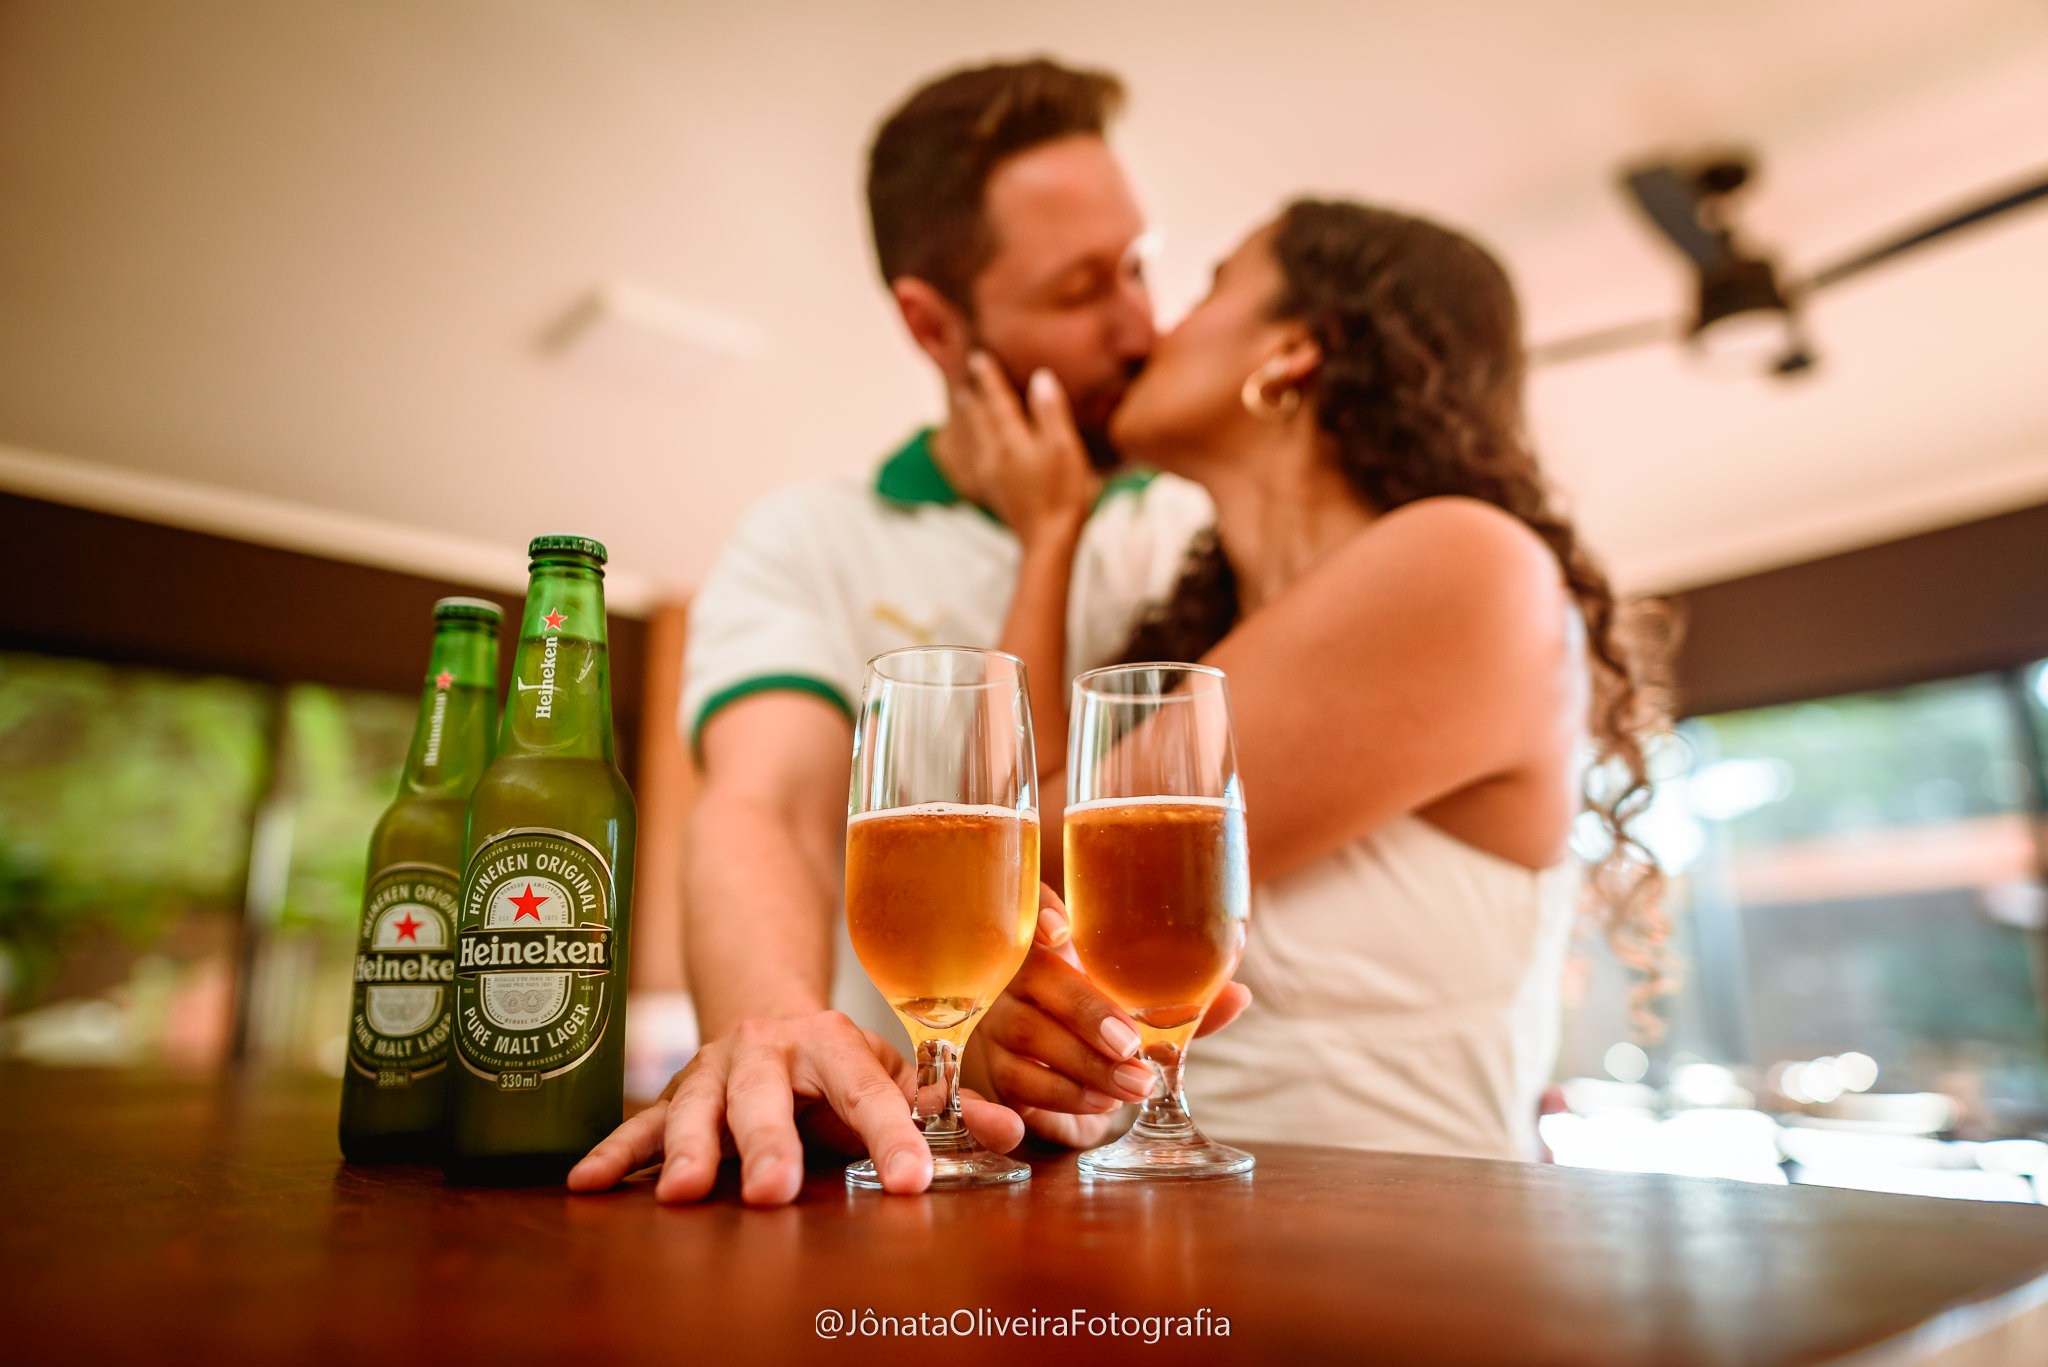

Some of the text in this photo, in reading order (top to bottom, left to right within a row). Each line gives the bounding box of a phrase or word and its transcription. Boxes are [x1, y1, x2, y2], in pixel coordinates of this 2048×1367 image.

[536, 636, 558, 719] Heineken
[512, 841, 543, 849] QUALITY
[469, 853, 528, 915] HEINEKEN
[536, 853, 597, 913] ORIGINAL
[460, 934, 605, 968] Heineken
[355, 953, 455, 982] Heineke
[464, 1003, 591, 1055] PURE MALT LAGER
[374, 1040, 413, 1058] MALT
[501, 1073, 537, 1088] 330ml
